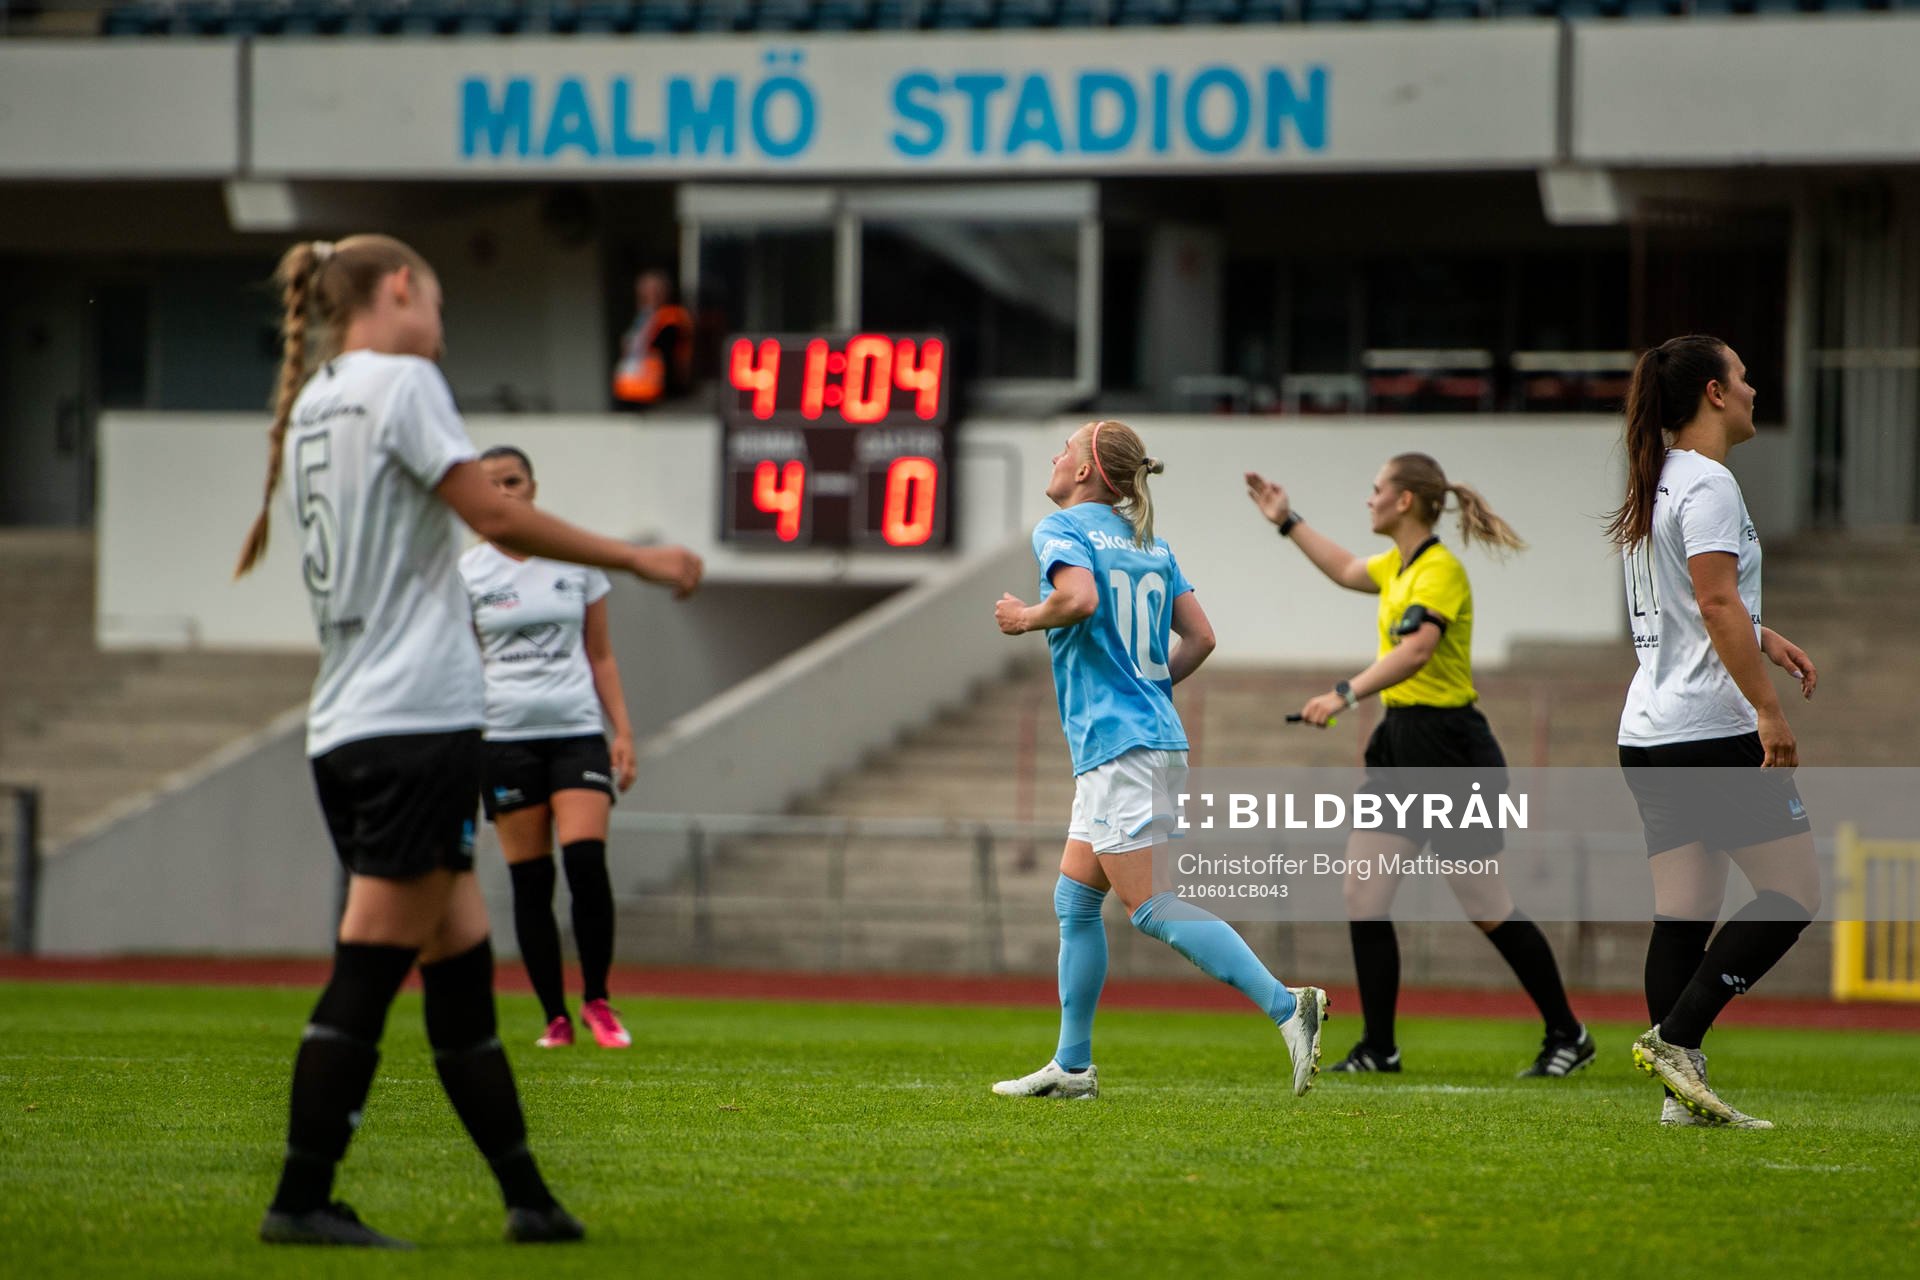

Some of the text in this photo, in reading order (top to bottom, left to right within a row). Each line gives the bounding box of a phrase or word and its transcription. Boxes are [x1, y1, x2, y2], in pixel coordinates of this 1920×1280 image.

[460, 50, 1329, 160] MALMÖ STADION
[729, 333, 944, 423] 41:04
[295, 430, 336, 597] 5
[752, 456, 938, 546] 4 0
[1109, 569, 1171, 681] 10
